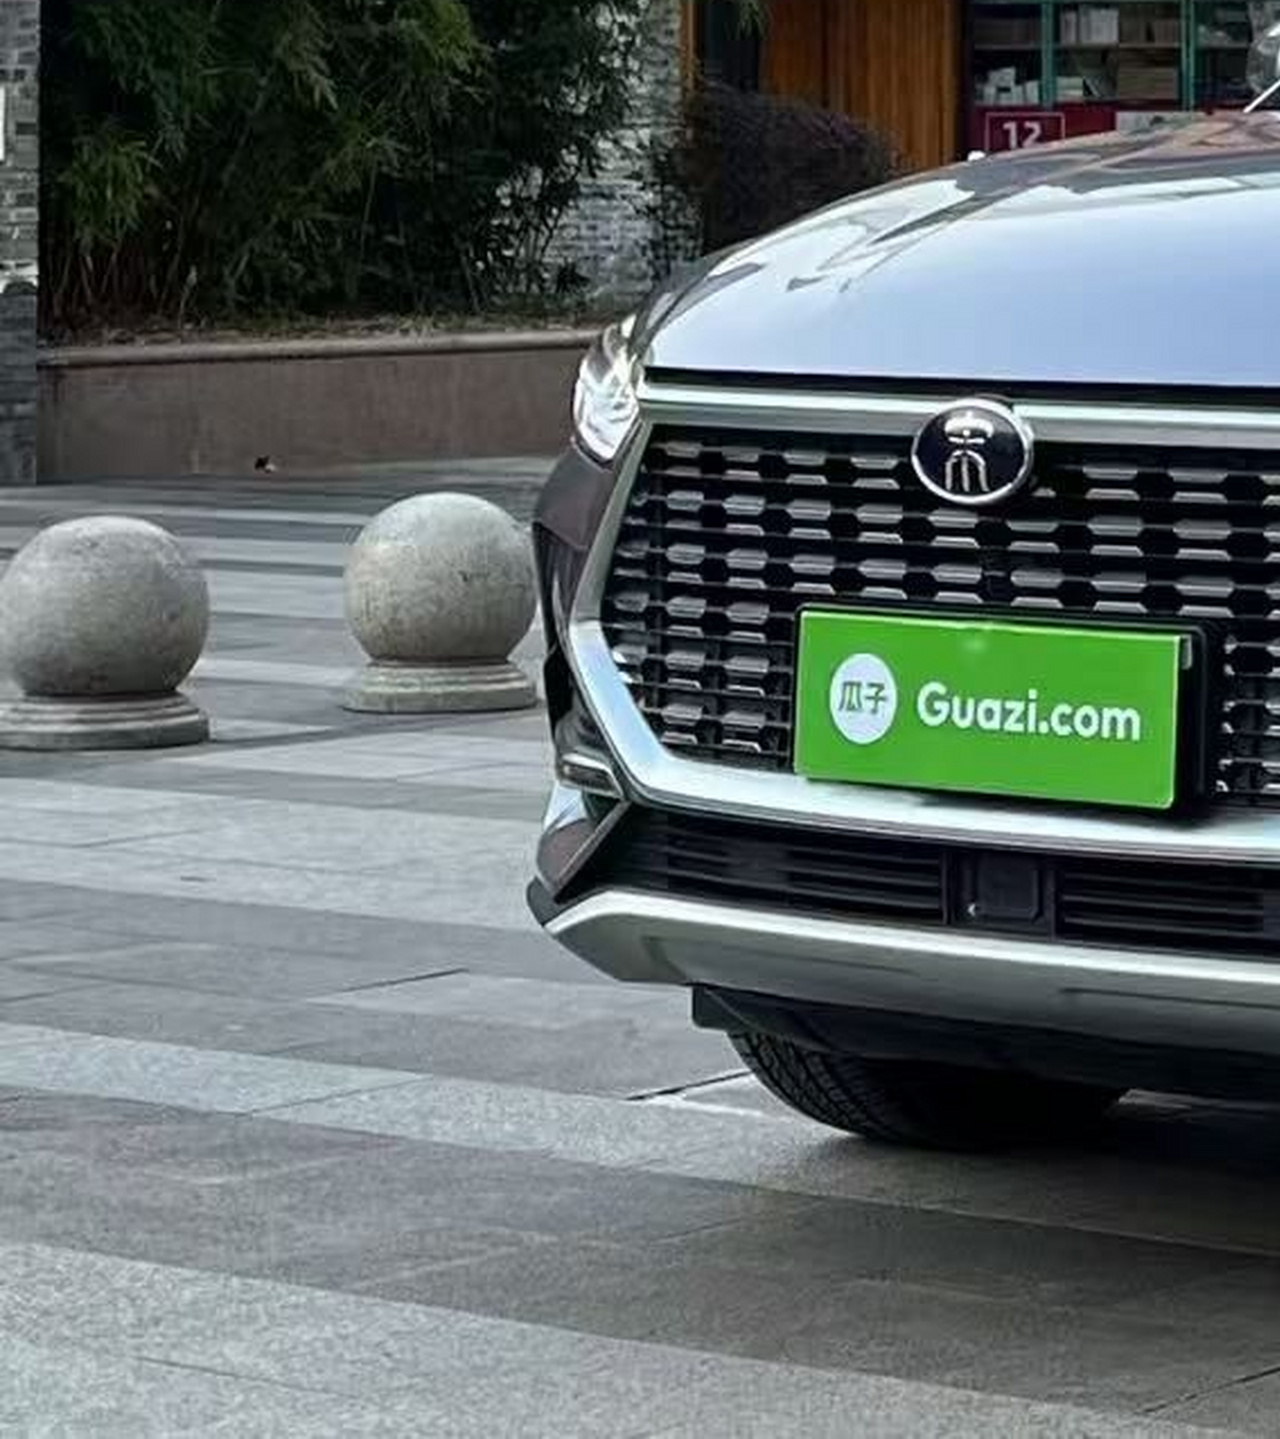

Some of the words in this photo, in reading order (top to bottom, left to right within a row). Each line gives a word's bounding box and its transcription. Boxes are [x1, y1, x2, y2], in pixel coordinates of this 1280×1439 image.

[1002, 120, 1043, 149] 12
[837, 680, 889, 715] 瓜子
[916, 681, 1141, 741] Guazi.com
